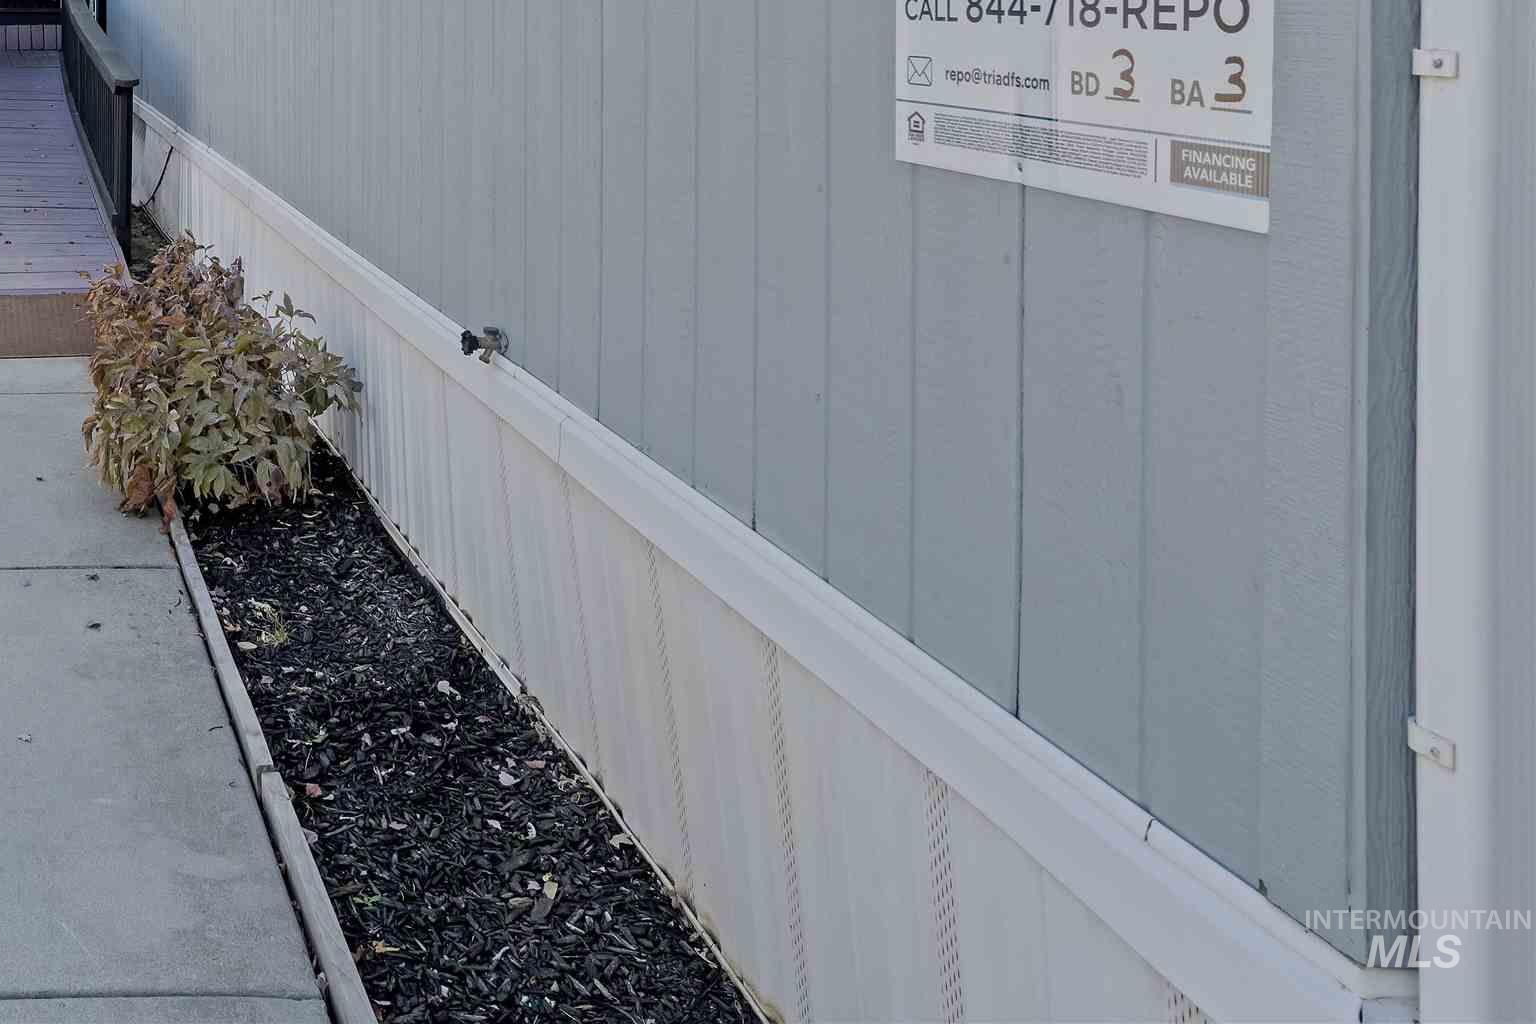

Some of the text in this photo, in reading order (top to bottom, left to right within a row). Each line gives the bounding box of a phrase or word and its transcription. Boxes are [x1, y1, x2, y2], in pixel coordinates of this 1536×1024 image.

[944, 67, 1051, 92] repo@triadfs.com
[1070, 70, 1100, 97] BD
[1111, 48, 1136, 98] 3
[1214, 56, 1247, 103] 3
[1169, 78, 1206, 108] BA
[1181, 148, 1257, 173] FINANCING
[1183, 166, 1254, 190] AVAILABLE
